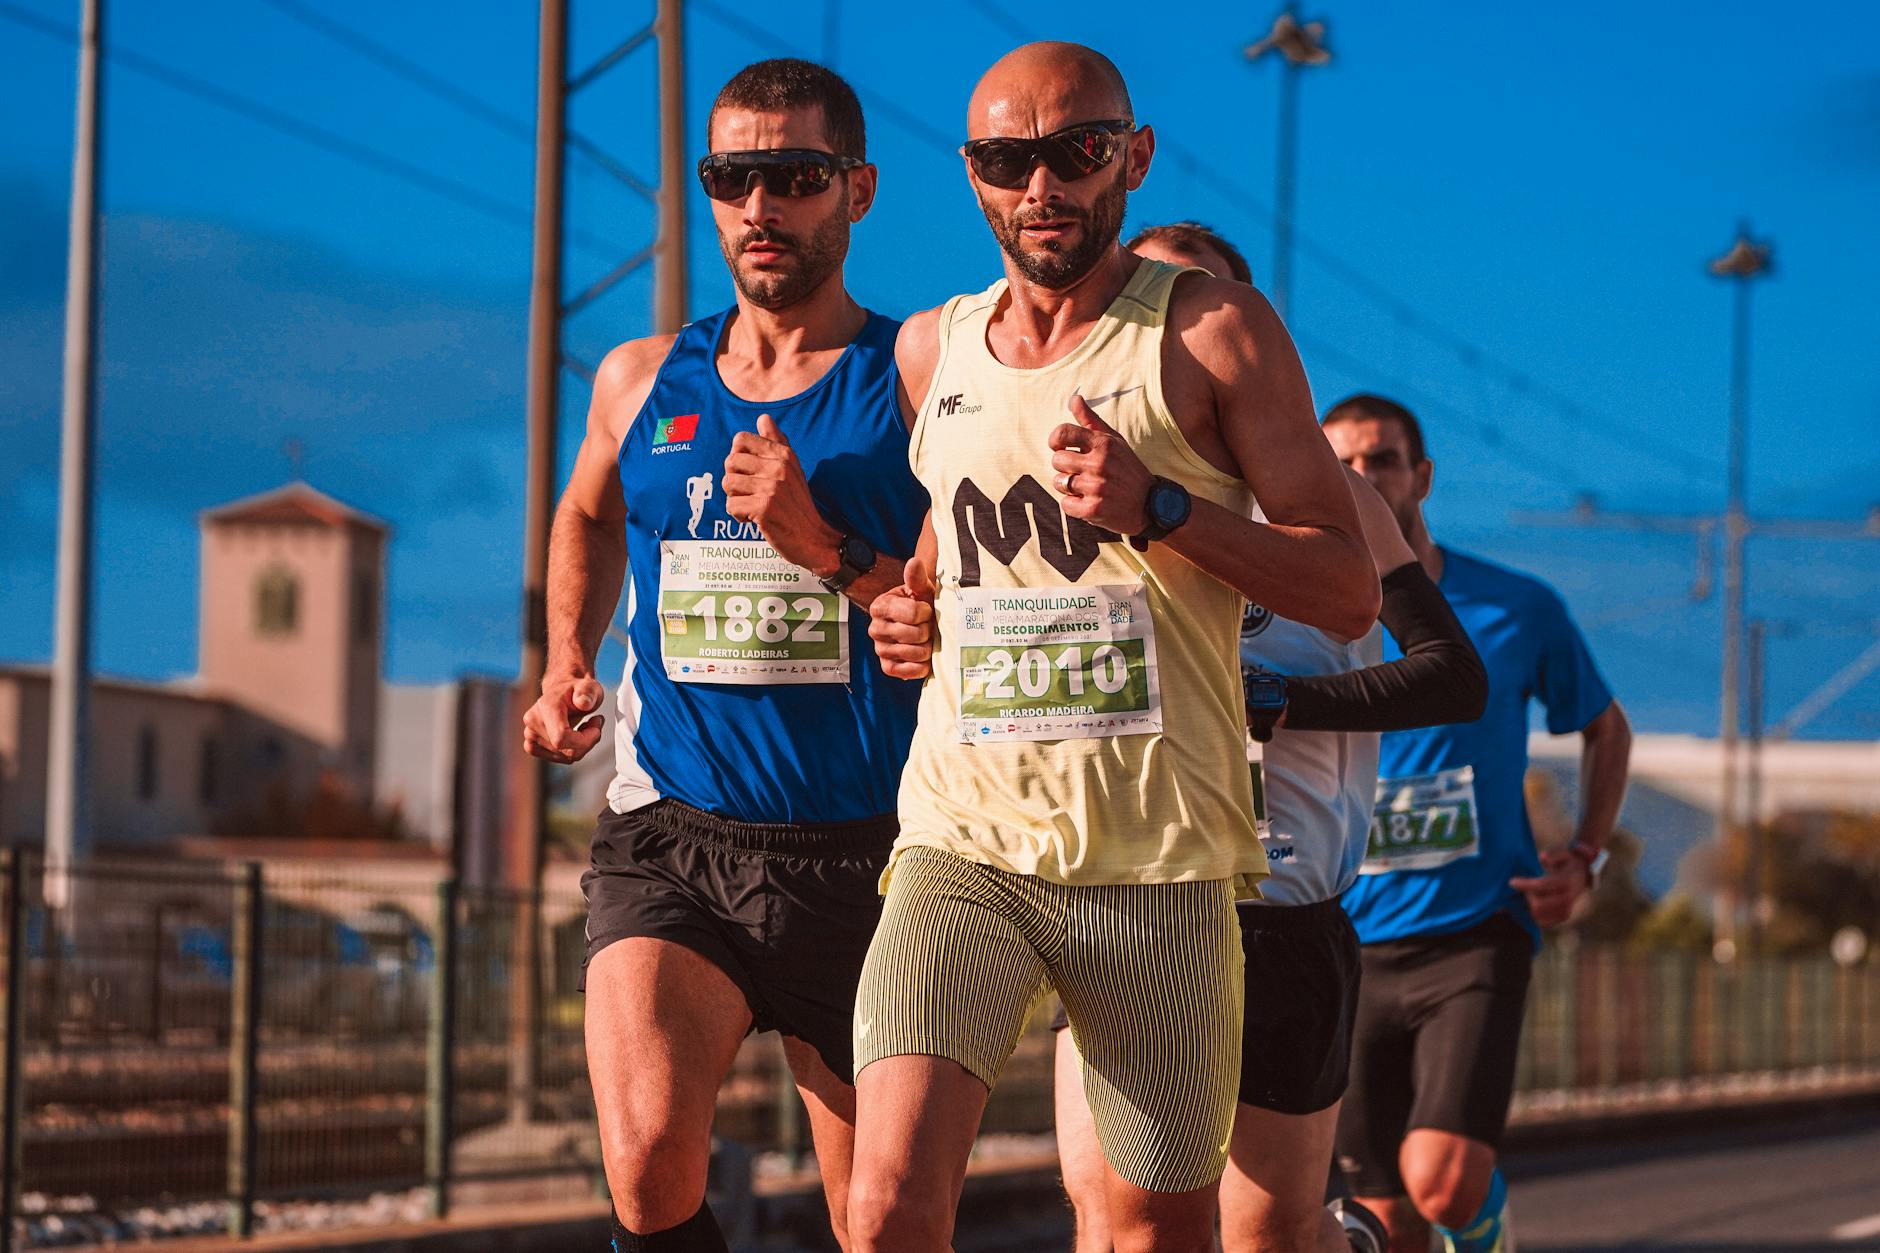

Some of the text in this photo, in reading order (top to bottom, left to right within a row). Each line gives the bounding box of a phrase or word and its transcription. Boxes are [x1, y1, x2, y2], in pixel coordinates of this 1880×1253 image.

[937, 393, 982, 418] MF Grupo
[651, 443, 691, 455] PORTUGAL
[713, 520, 765, 539] RUN
[699, 547, 782, 560] TRANQUILIDA
[698, 562, 801, 572] MEIA MARATONA DOS
[698, 571, 800, 583] DESCOBRIMENTOS
[992, 596, 1097, 612] TRANQUILIDADE
[1108, 601, 1132, 610] TRAN
[1243, 600, 1265, 619] jo
[692, 595, 825, 643] 1882
[992, 612, 1098, 624] MEIA MARATONA DOS
[1111, 615, 1135, 624] DADE
[966, 622, 985, 630] DADE
[993, 622, 1099, 635] DESCOBRIMENTOS
[699, 647, 789, 659] ROBERTO LADEIRAS
[985, 645, 1128, 699] 2010
[1000, 705, 1095, 718] RICARDO MADEIRA
[1372, 806, 1459, 848] 1877
[1265, 846, 1293, 860] OM
